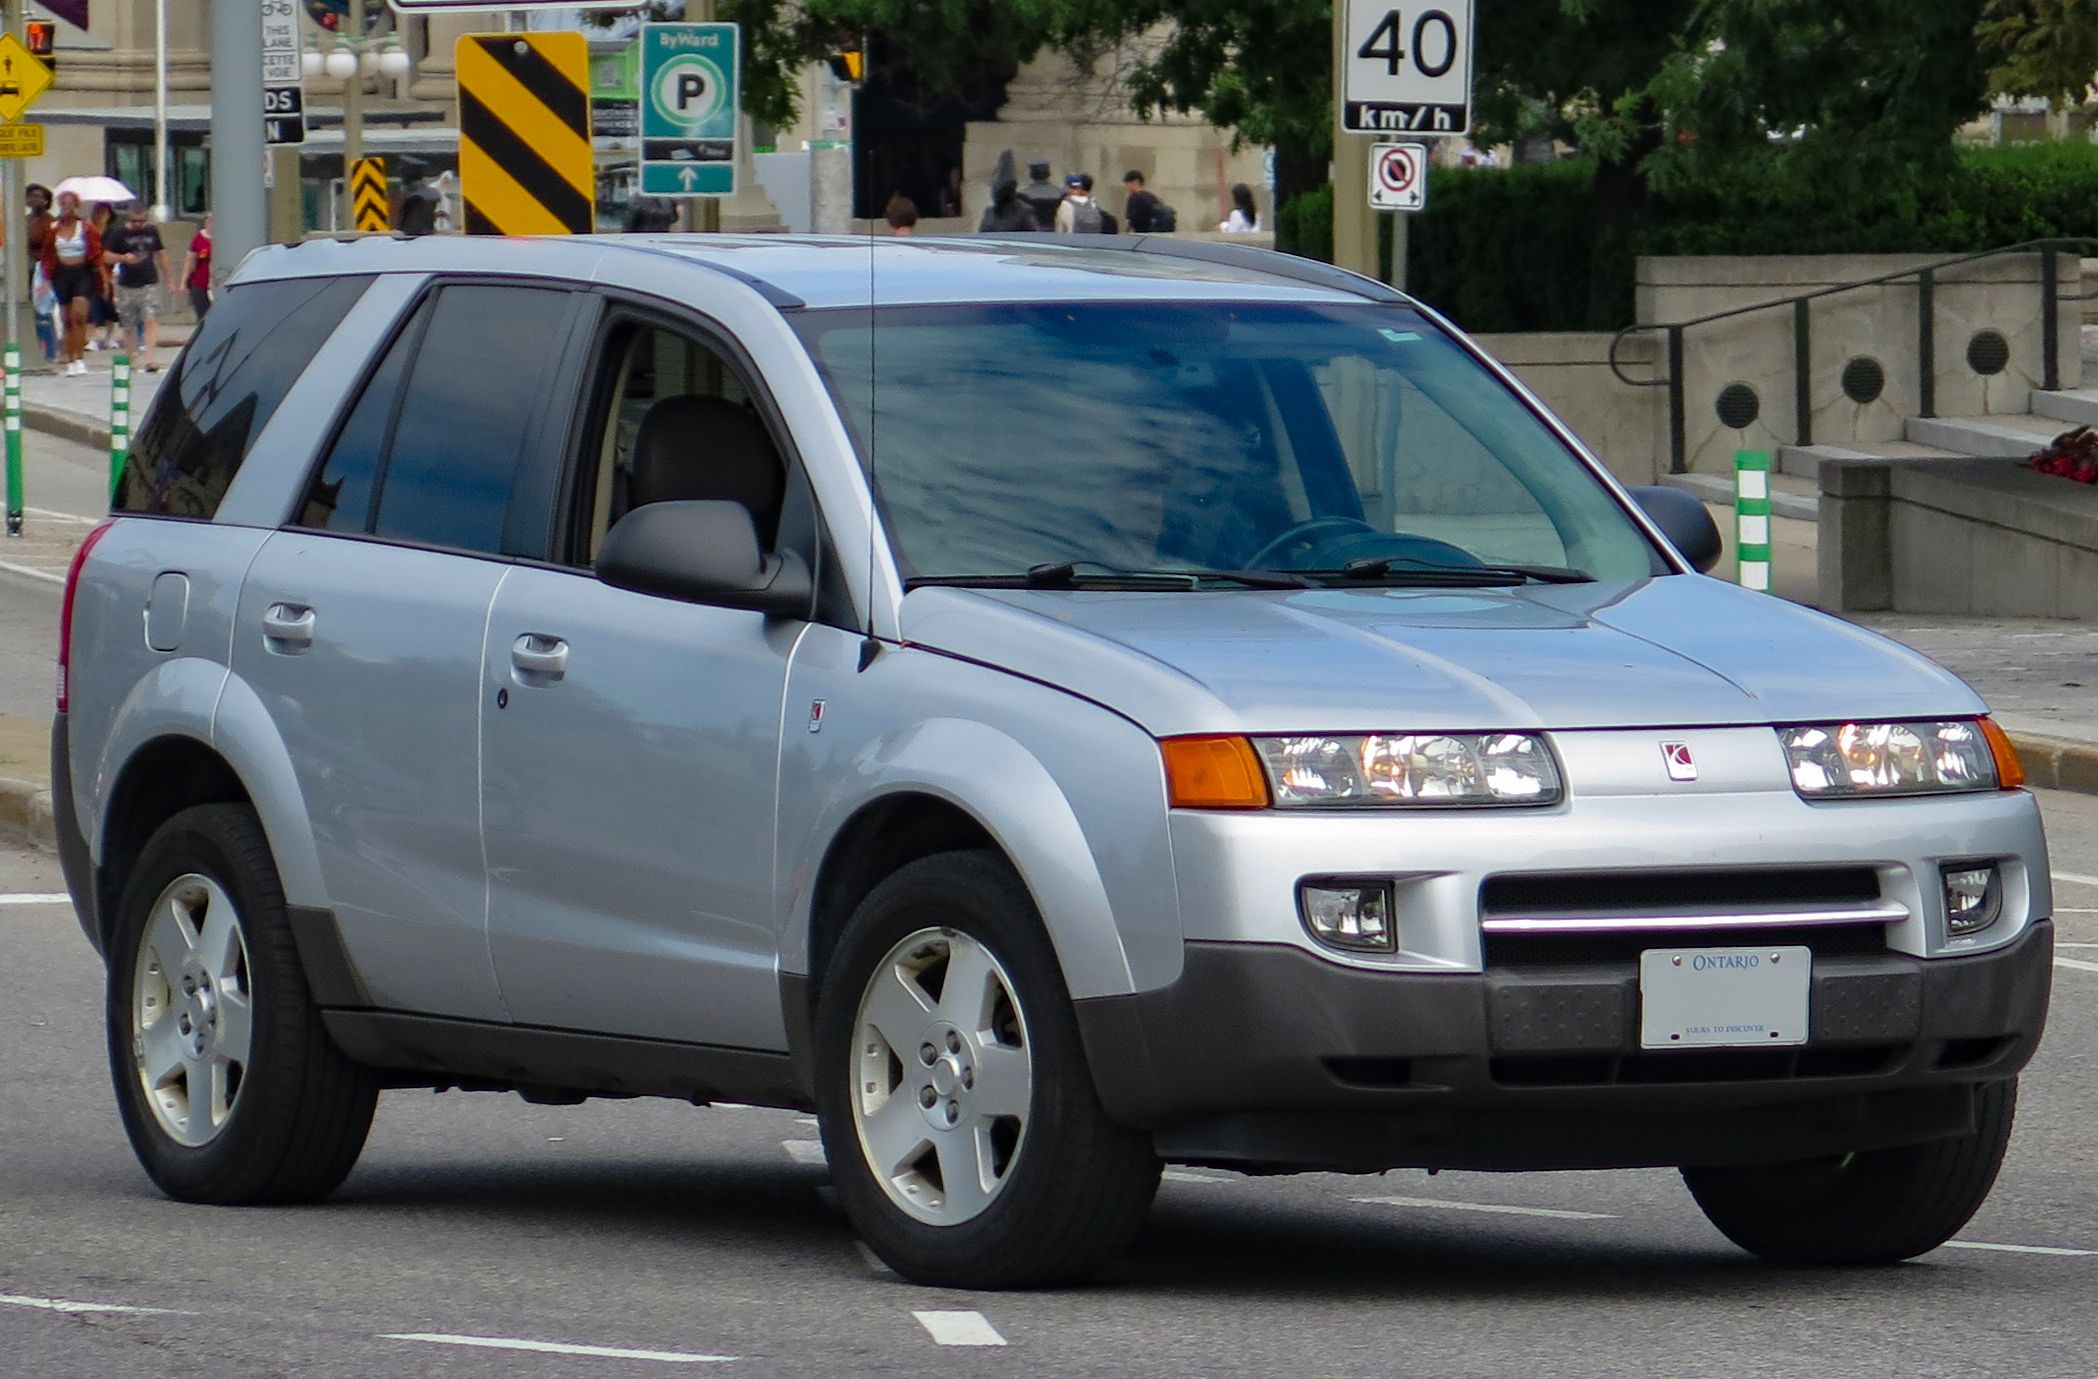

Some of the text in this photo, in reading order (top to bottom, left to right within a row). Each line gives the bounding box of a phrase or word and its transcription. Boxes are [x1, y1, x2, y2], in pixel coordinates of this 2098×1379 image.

[659, 32, 720, 49] ByWard
[1357, 9, 1457, 77] 40
[264, 91, 292, 110] DS
[677, 73, 705, 110] P
[1359, 105, 1450, 130] km/h
[1692, 954, 1760, 971] ONTARIO
